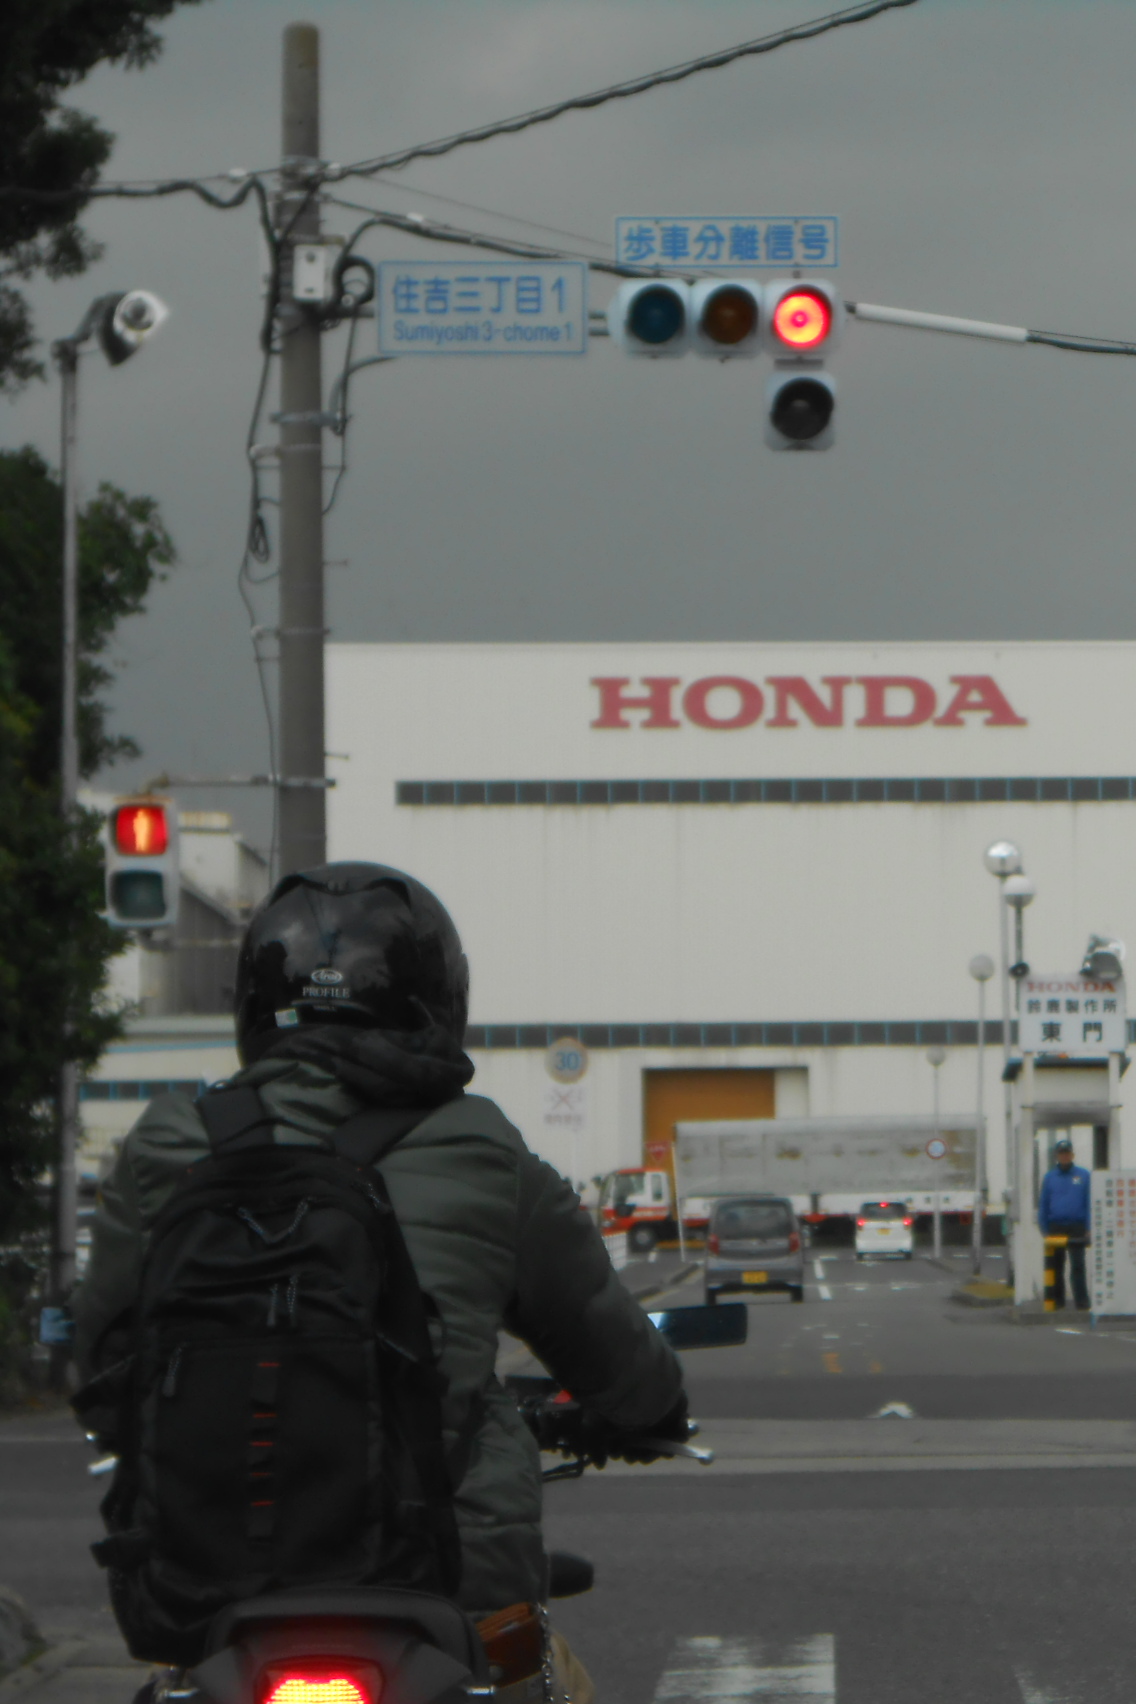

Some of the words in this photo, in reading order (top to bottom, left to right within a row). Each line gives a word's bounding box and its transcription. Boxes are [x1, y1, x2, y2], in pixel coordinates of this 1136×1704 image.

[623, 223, 831, 263] 歩車分離信号
[393, 319, 480, 345] Sumiyoshi
[589, 674, 1029, 730] HONDA
[302, 986, 351, 998] PROFILE
[1026, 981, 1117, 993] HONDA
[1027, 998, 1118, 1014] 鈴鹿製作所
[1041, 1021, 1103, 1042] 東門
[555, 1050, 580, 1071] 30
